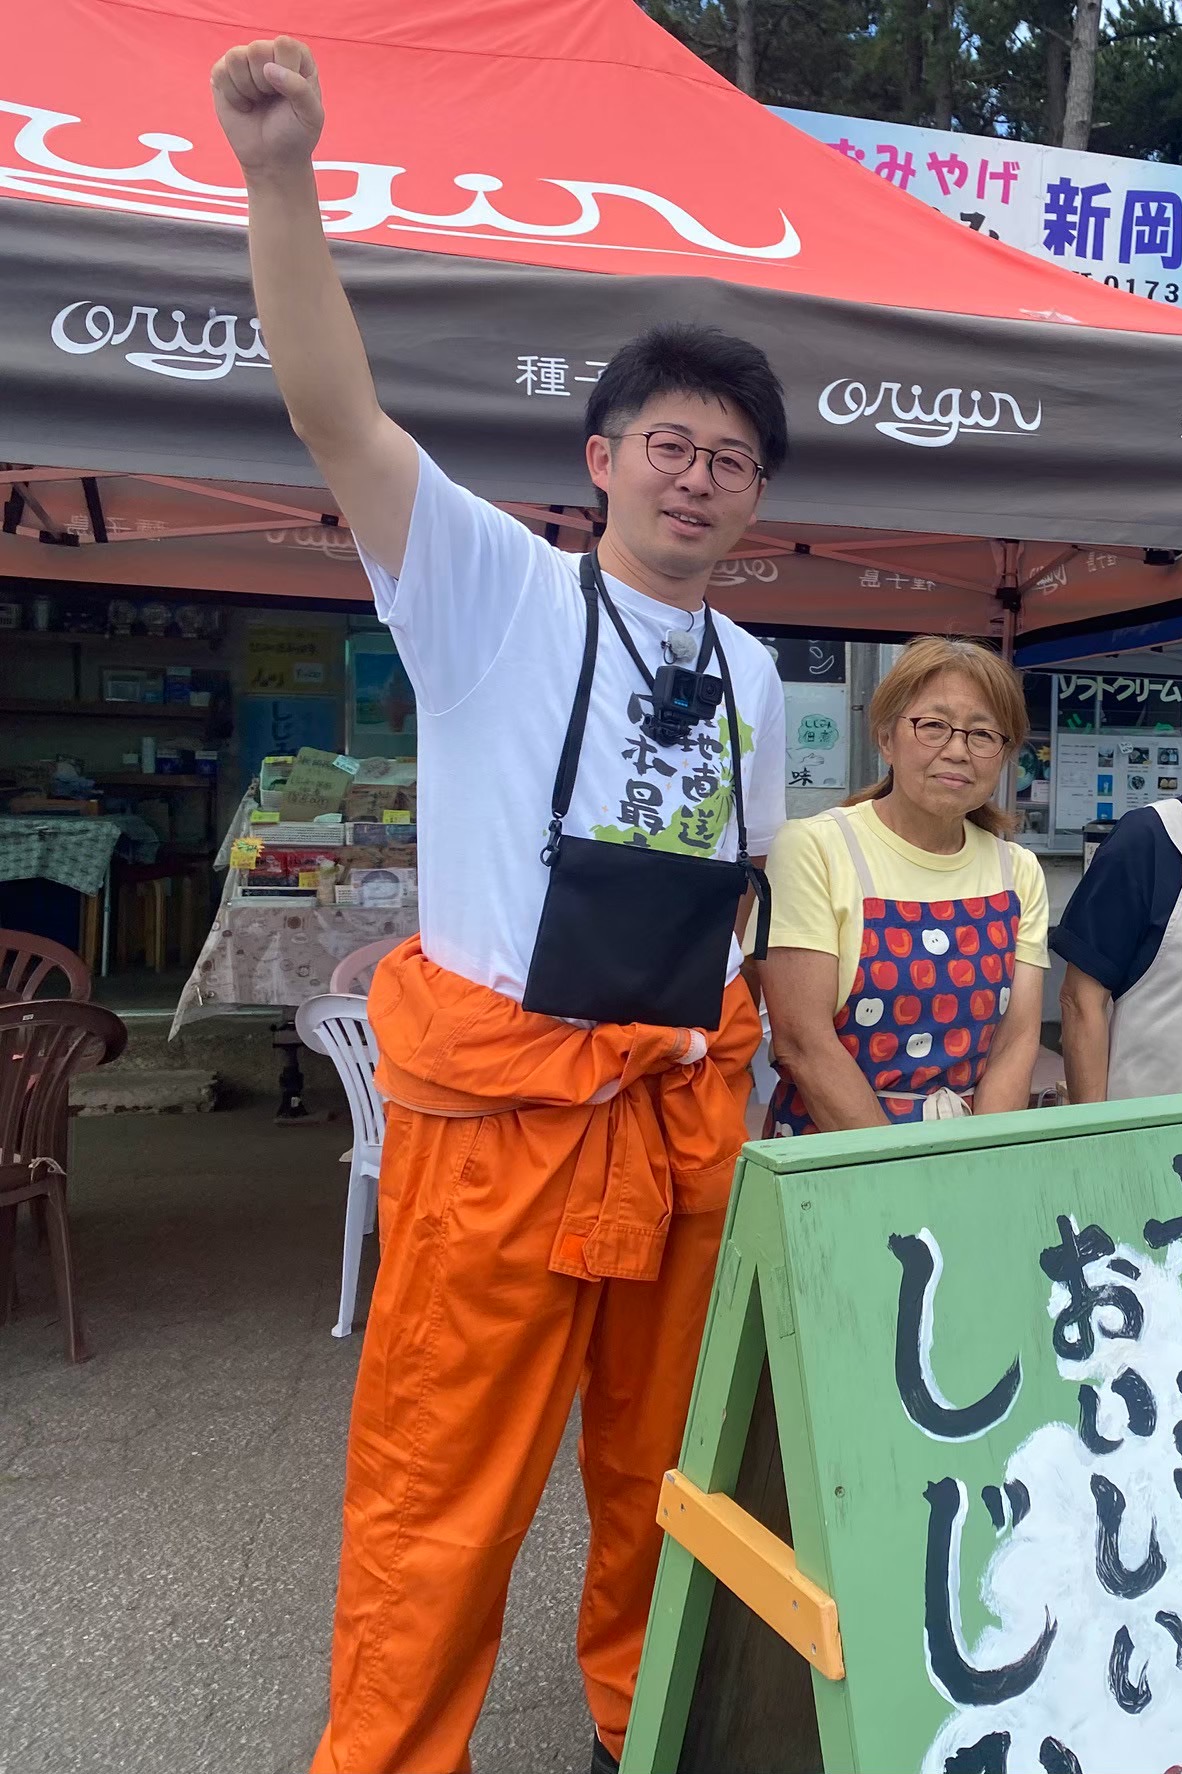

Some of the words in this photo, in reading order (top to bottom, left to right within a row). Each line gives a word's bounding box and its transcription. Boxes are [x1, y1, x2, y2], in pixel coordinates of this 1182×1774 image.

[0, 102, 802, 258] rigin
[515, 356, 610, 395] 種子
[1058, 674, 1182, 702] ソフトクリーム
[677, 719, 724, 849] 地直送
[888, 1232, 1082, 1774] しじ
